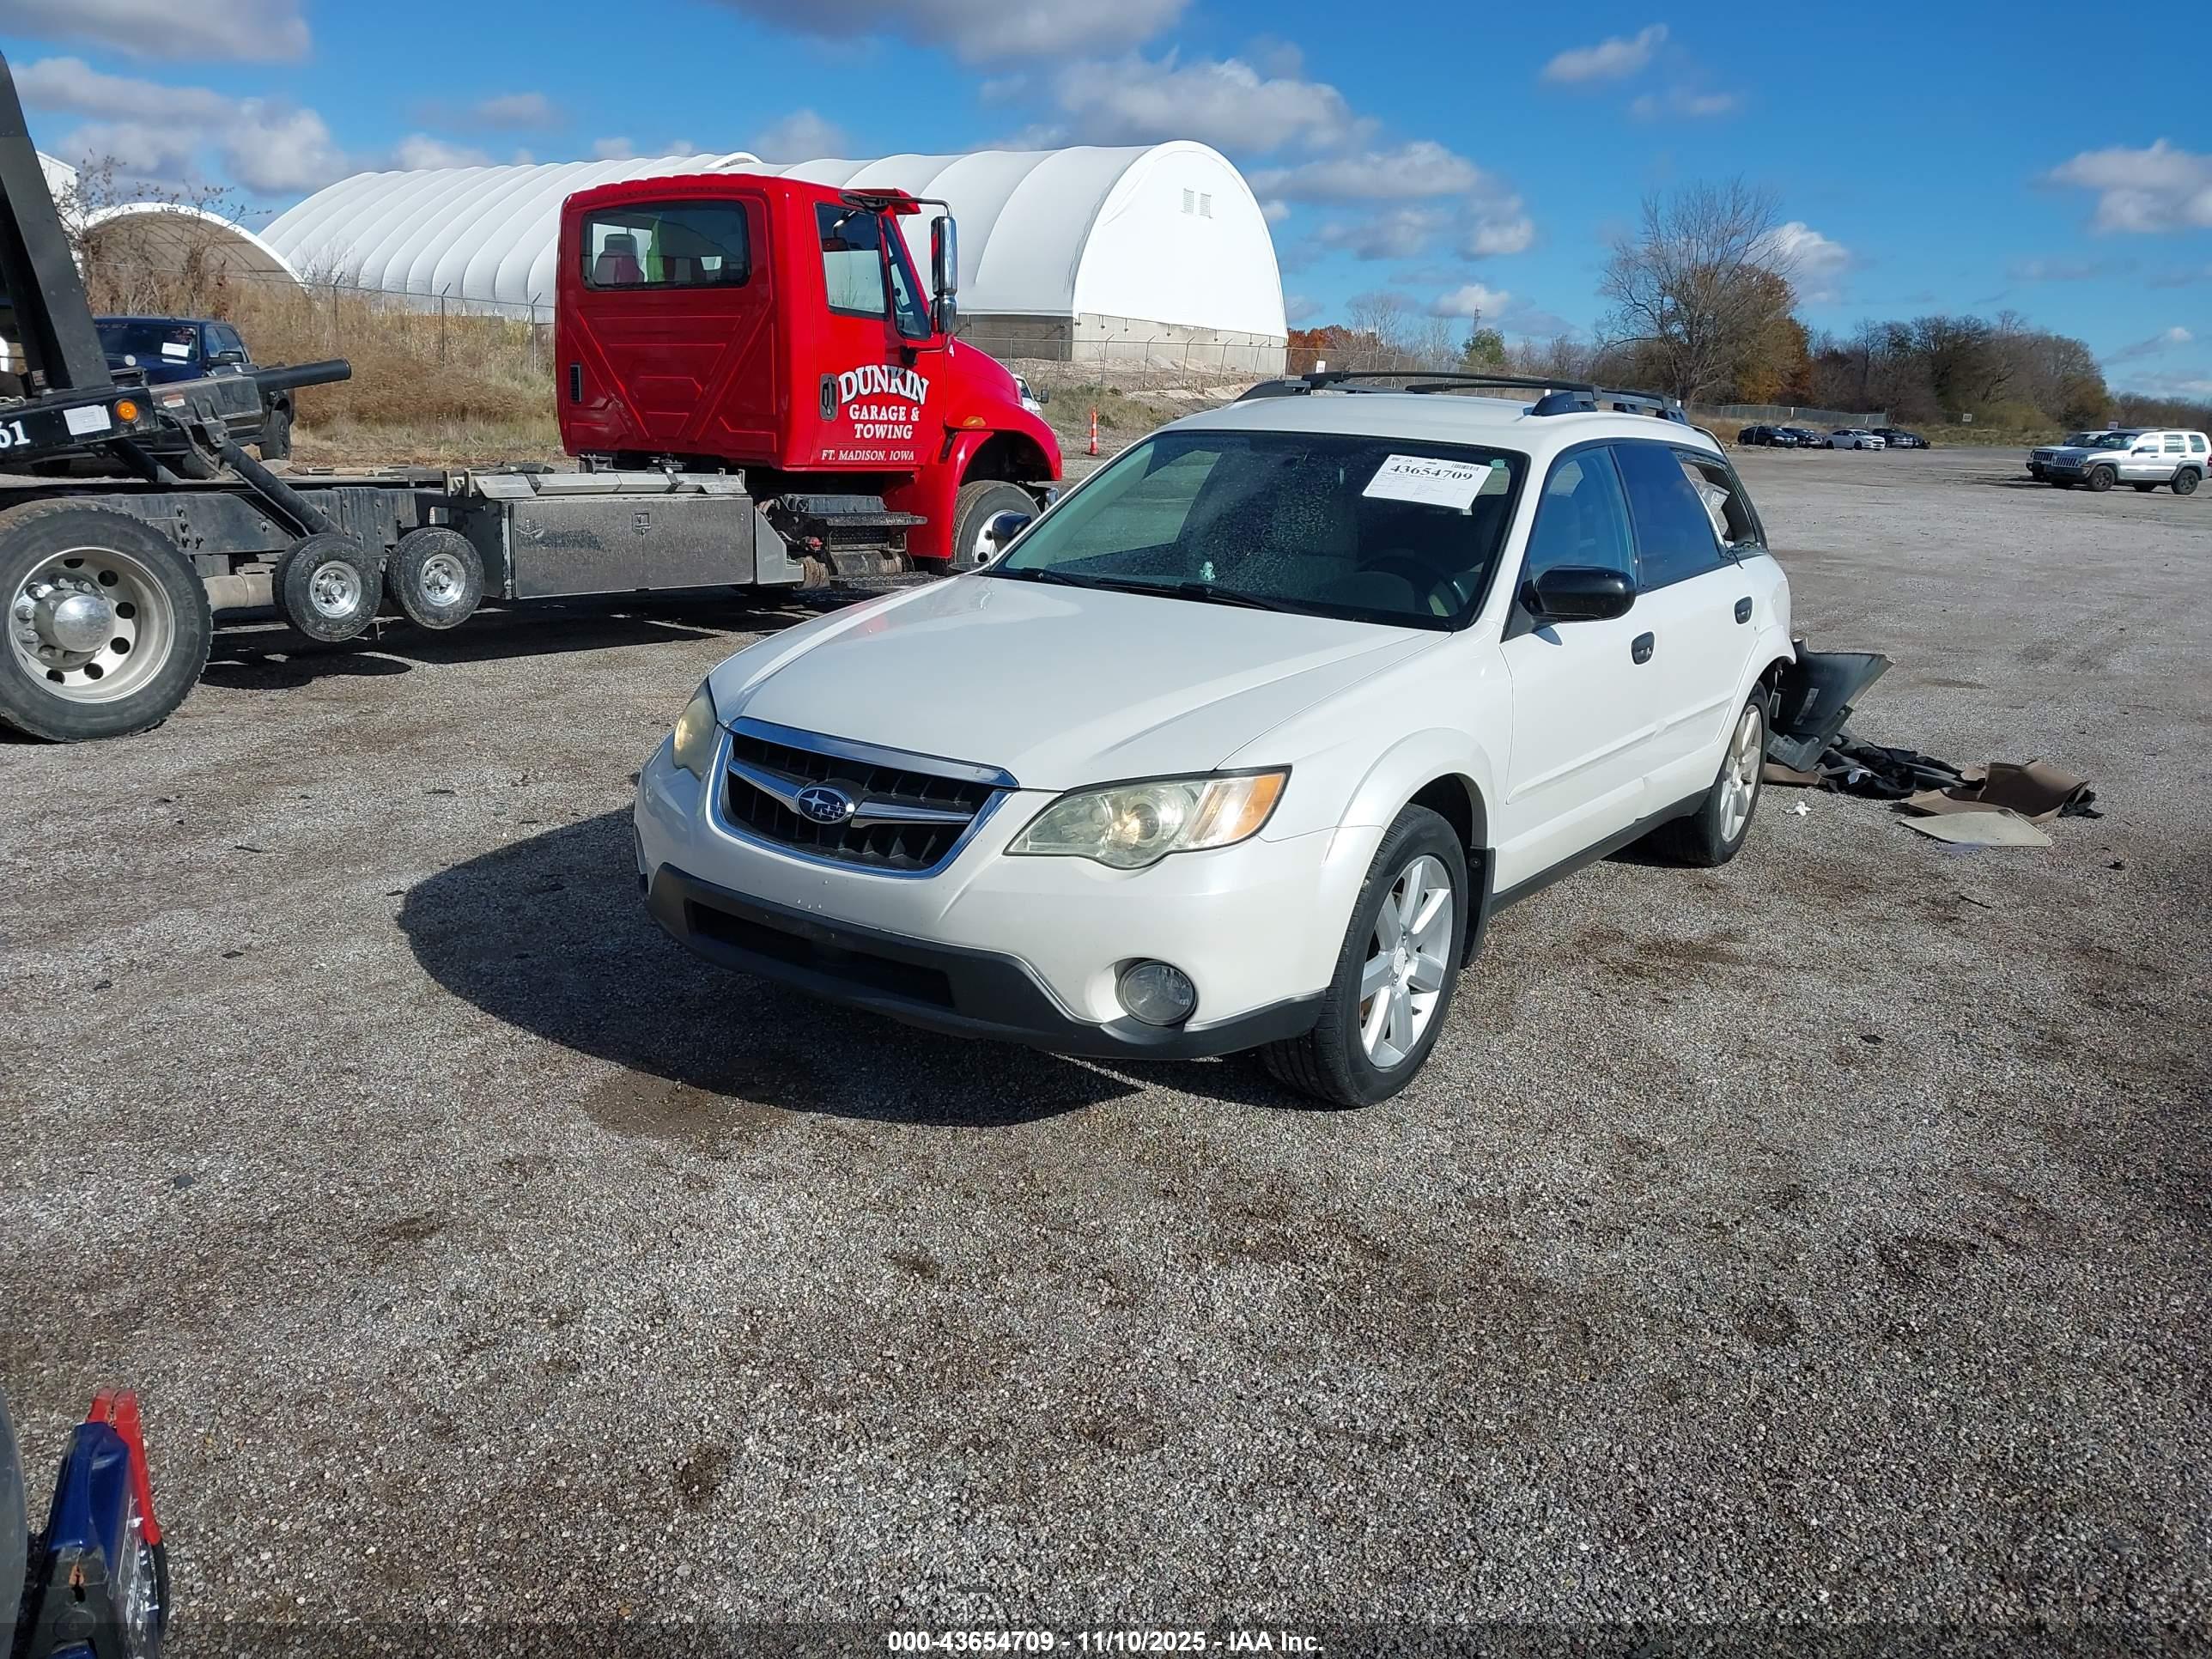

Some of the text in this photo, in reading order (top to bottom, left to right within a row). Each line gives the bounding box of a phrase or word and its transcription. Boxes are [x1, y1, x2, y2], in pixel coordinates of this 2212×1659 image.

[838, 364, 930, 405] DUNKIN
[849, 404, 921, 422] GARAGE &
[854, 423, 914, 440] TOWING
[821, 449, 915, 462] FT. MADISON, IOWA
[1390, 465, 1474, 481] 43654709
